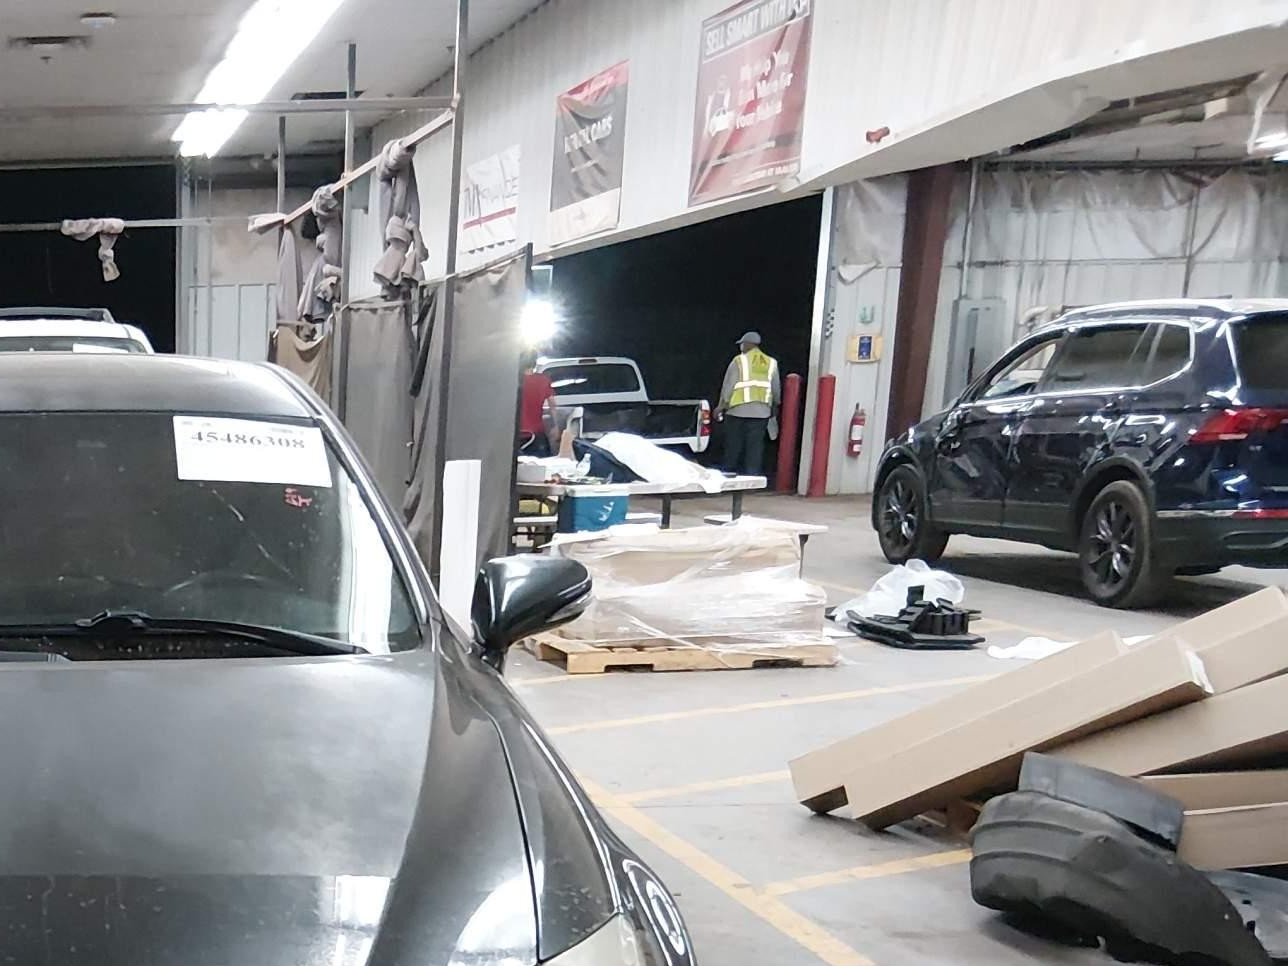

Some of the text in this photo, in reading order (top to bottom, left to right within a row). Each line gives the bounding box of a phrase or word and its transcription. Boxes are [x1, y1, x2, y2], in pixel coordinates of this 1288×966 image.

[706, 25, 725, 55] SELL
[727, 9, 759, 45] SMART
[191, 431, 305, 448] 45486308
